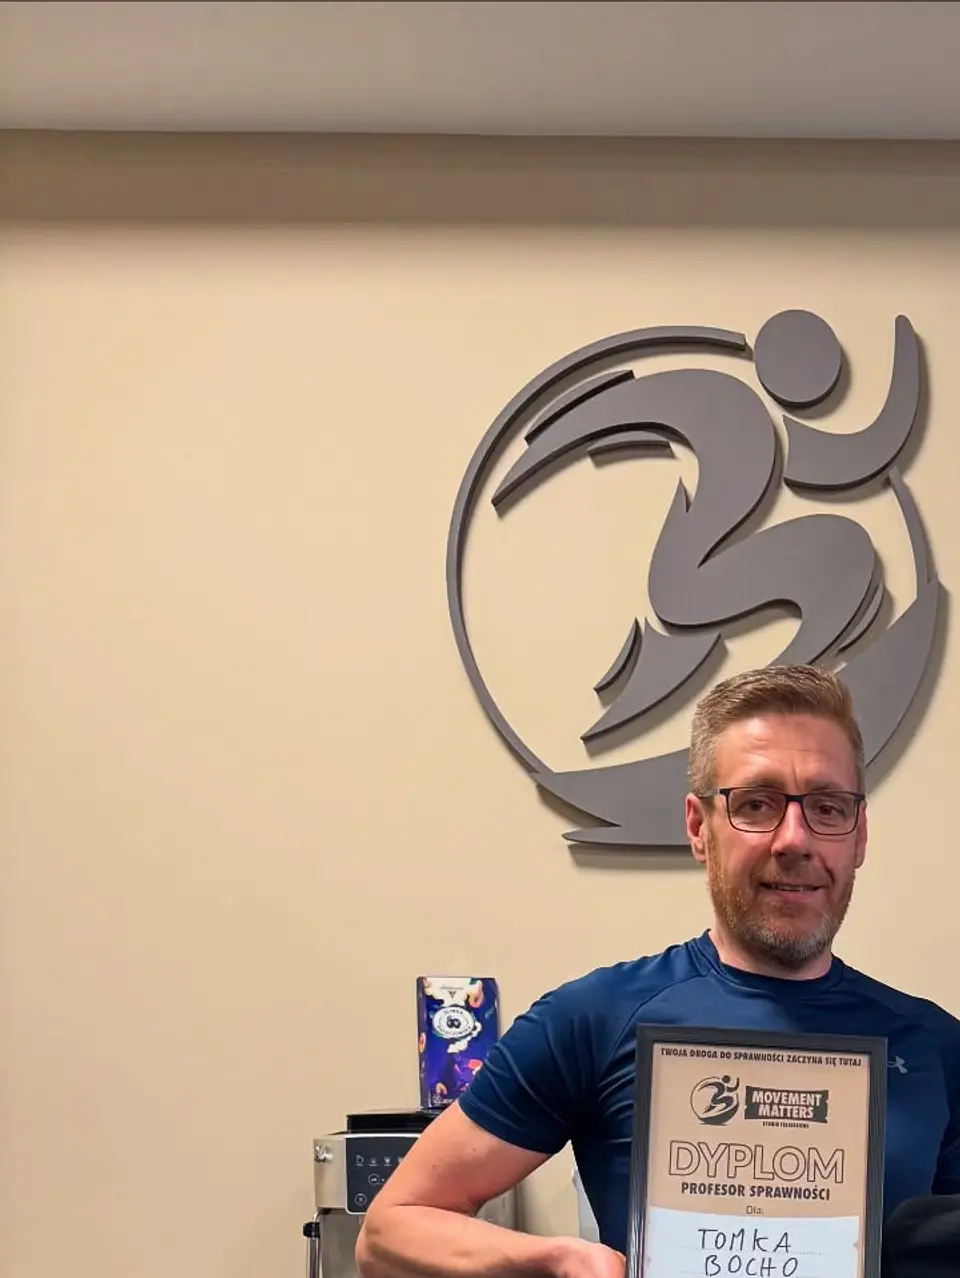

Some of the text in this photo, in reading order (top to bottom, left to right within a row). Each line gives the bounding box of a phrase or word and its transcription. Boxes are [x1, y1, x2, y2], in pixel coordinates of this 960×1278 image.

[661, 1048, 688, 1057] TWOJA
[720, 1051, 732, 1059] DO
[733, 1051, 784, 1062] SPRAWNOŚCI
[787, 1054, 822, 1064] ZACZYNA
[825, 1056, 837, 1067] SIĘ
[839, 1057, 862, 1066] TUTAJ
[752, 1090, 822, 1106] MOVEMENT
[758, 1104, 814, 1119] MATTERS
[668, 1140, 845, 1184] DYPLOM
[681, 1182, 830, 1201] PROFESOR SPRAWNOŚCI
[746, 1205, 764, 1215] Dla:
[698, 1228, 792, 1253] TOMKA
[705, 1255, 798, 1277] BOCHO
